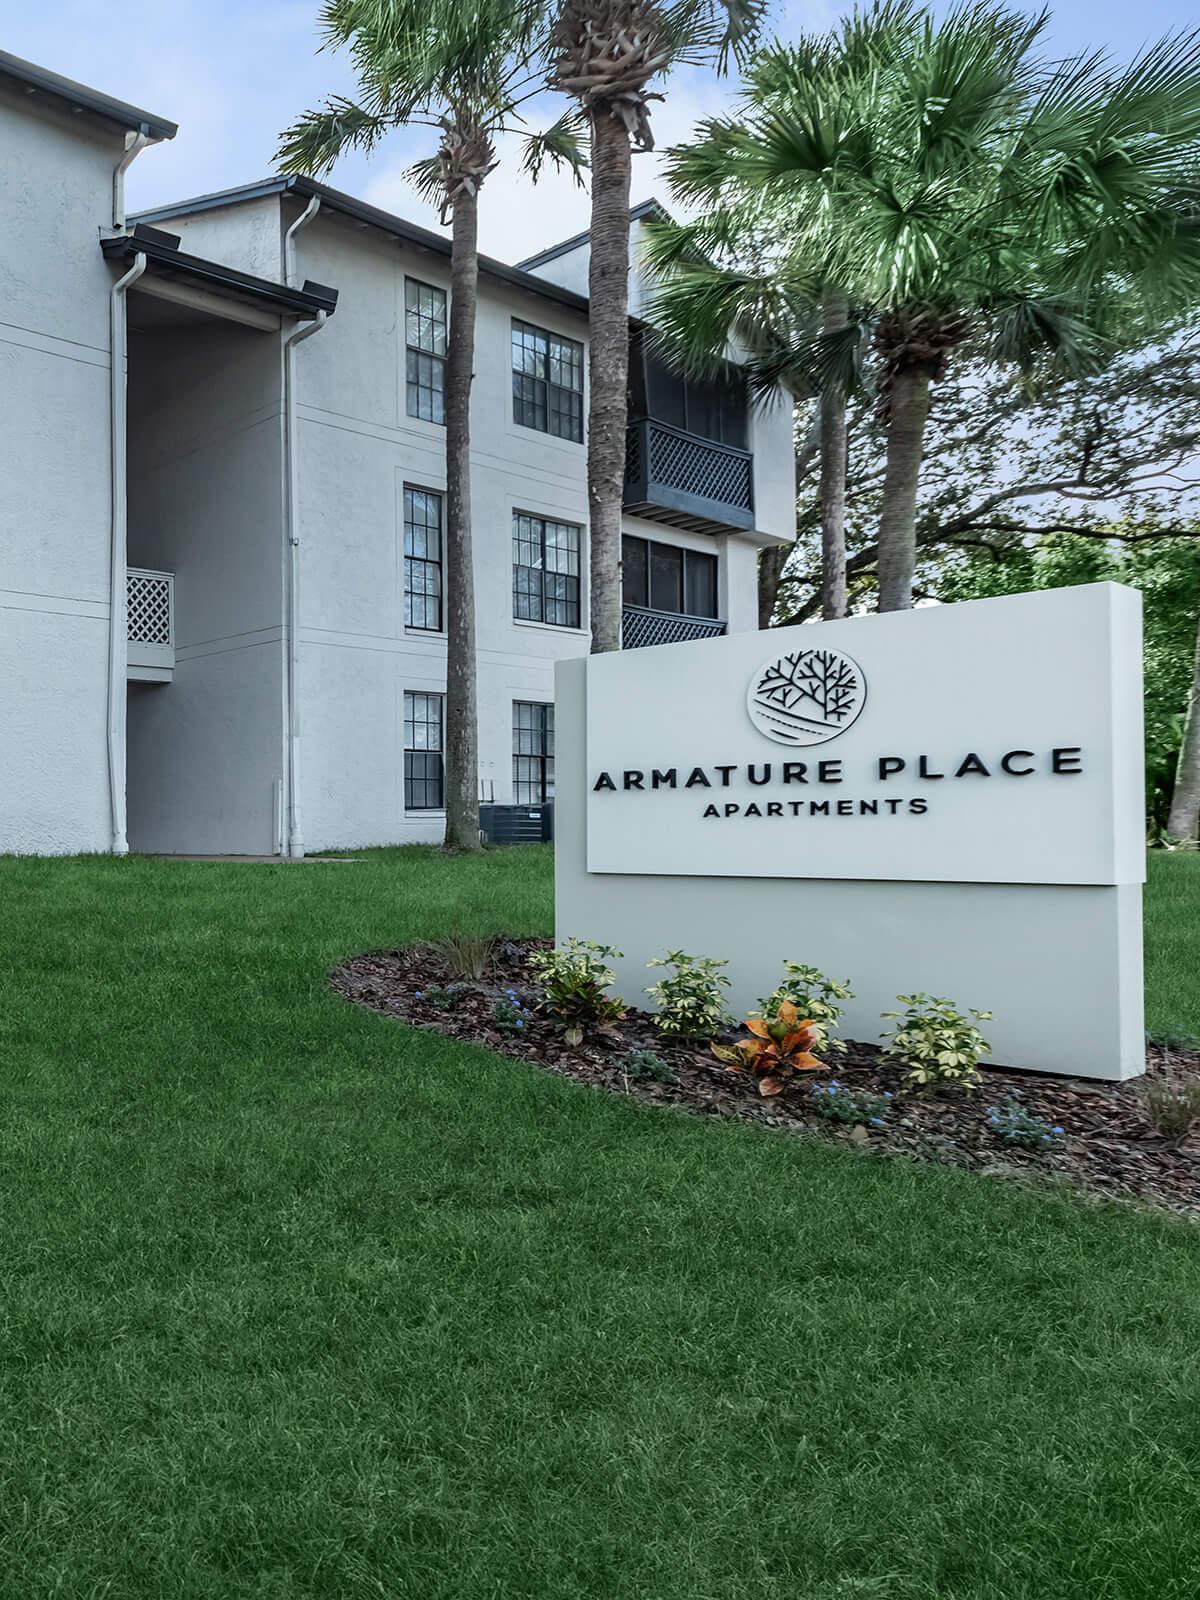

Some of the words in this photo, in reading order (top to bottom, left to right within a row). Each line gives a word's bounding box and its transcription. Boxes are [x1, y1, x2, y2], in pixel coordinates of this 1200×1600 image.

[593, 759, 843, 792] ARMATURE
[878, 747, 1083, 781] PLACE
[703, 798, 928, 818] APARTMENTS
